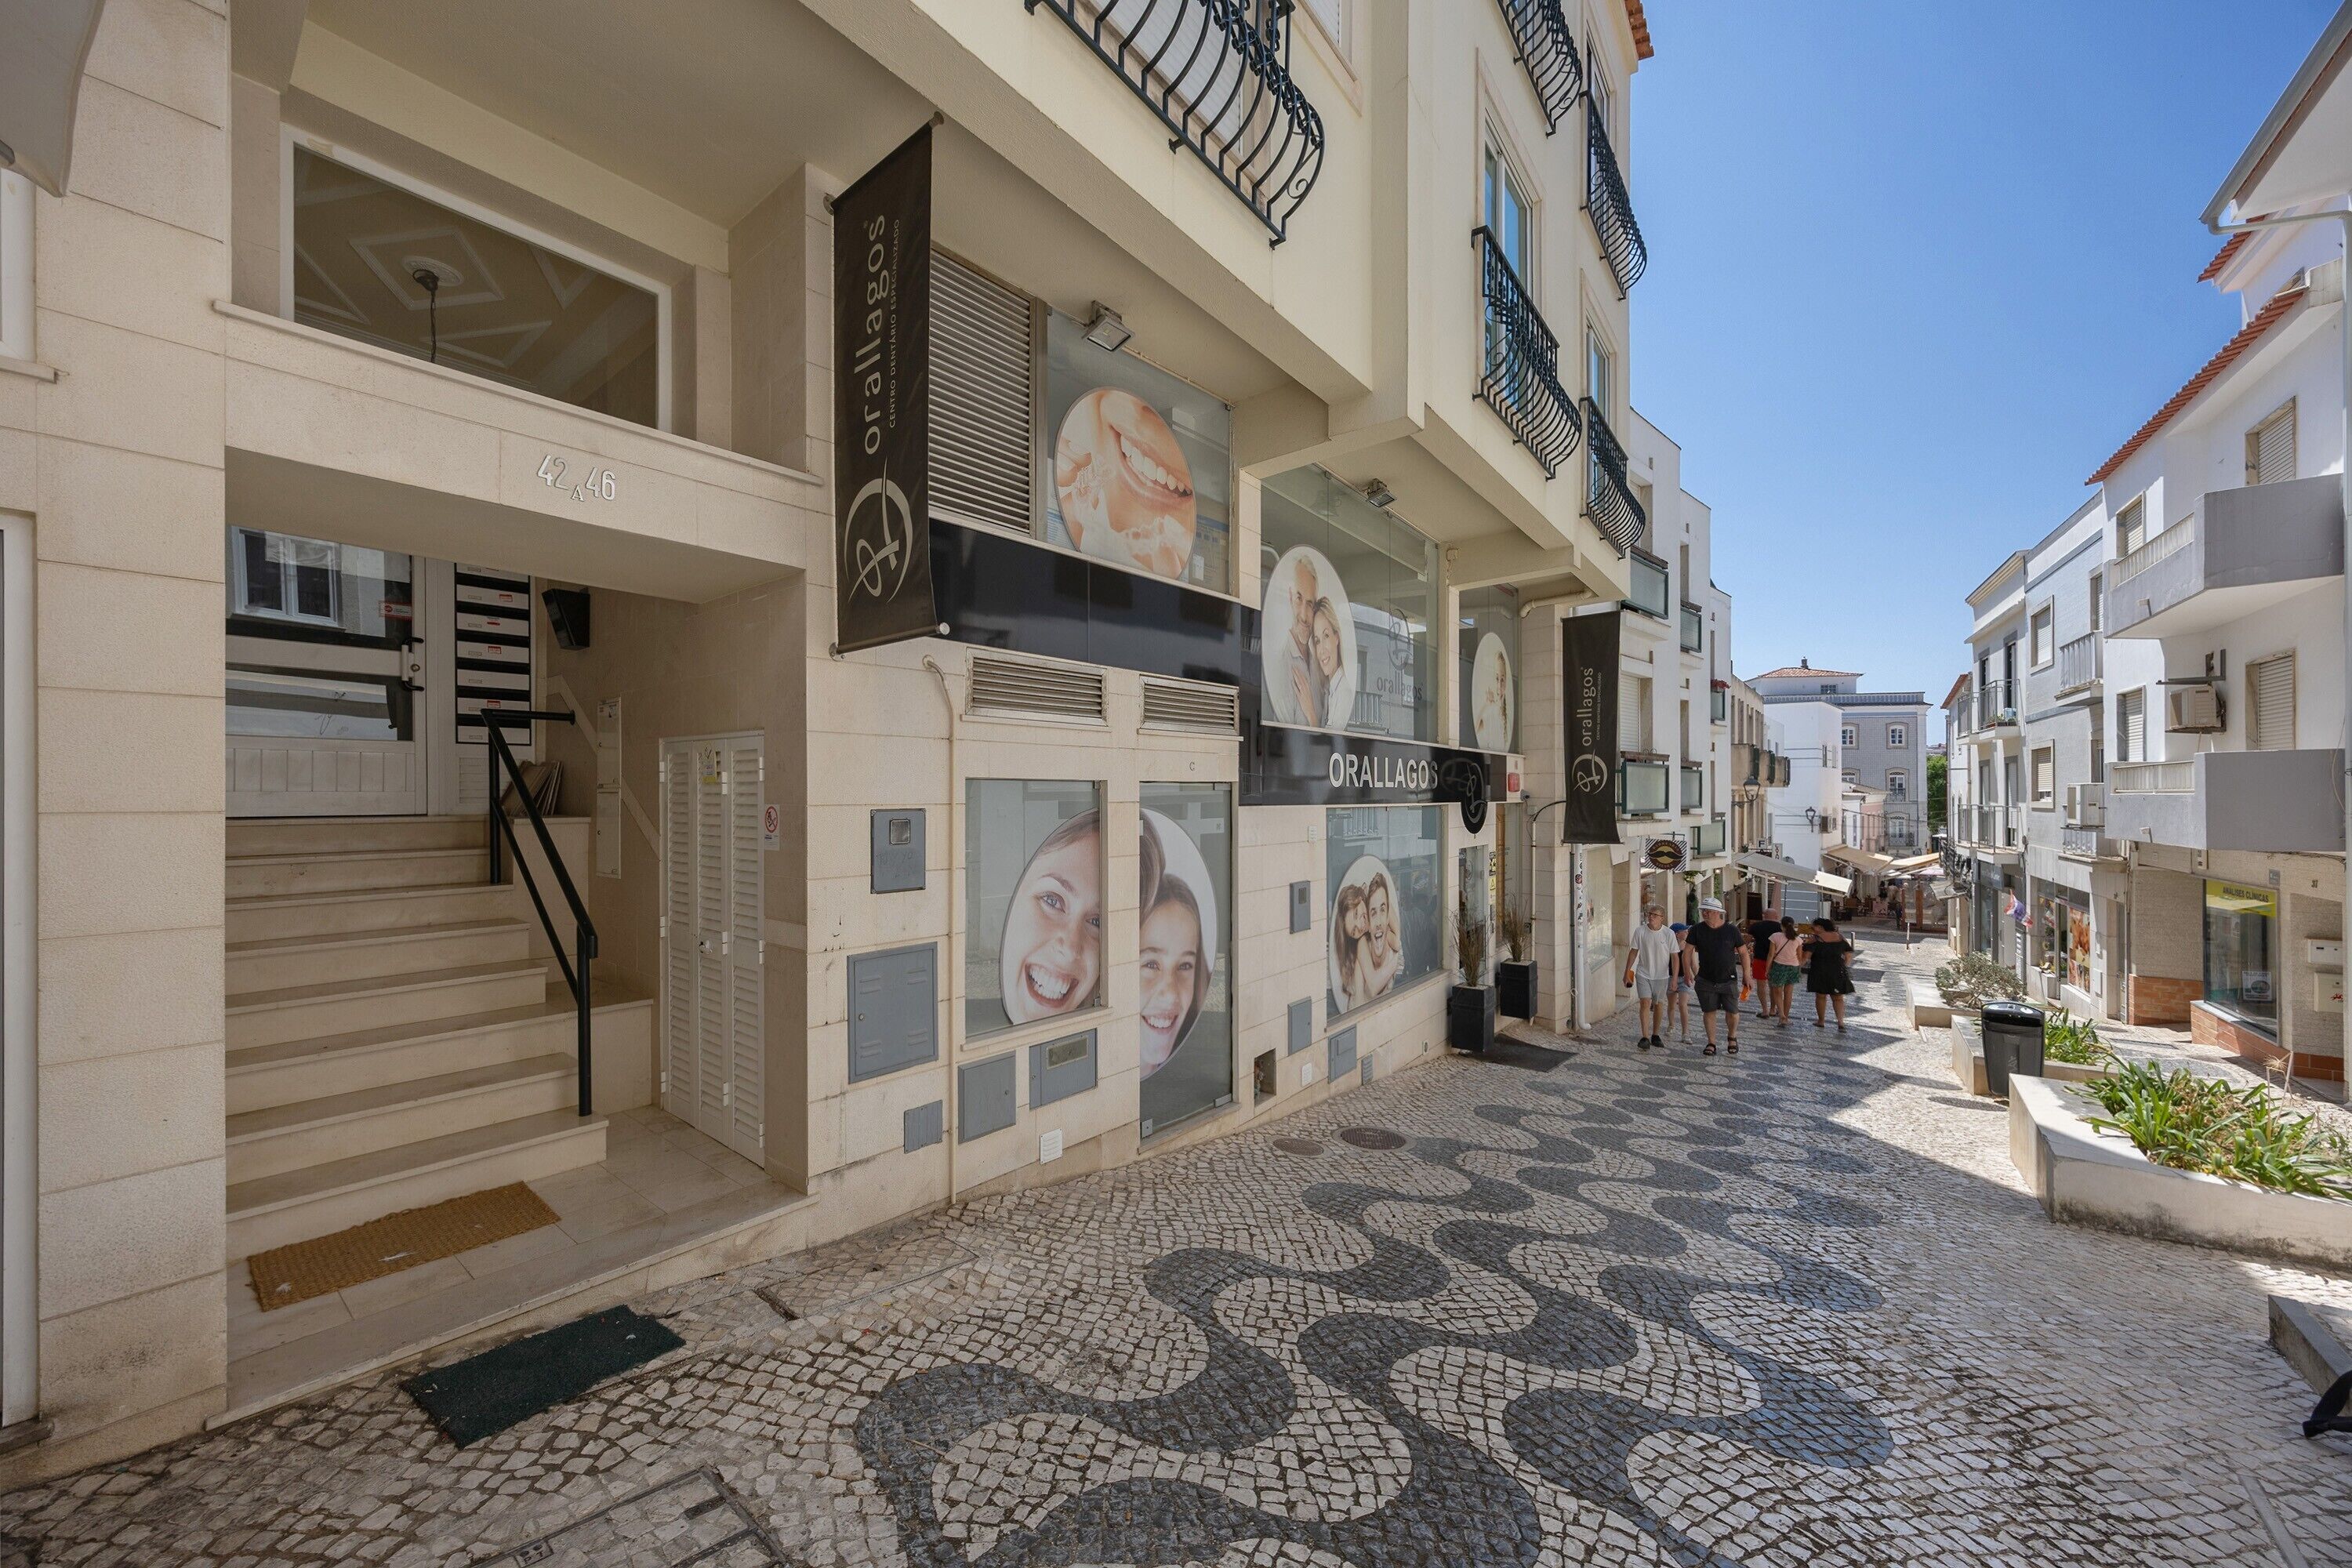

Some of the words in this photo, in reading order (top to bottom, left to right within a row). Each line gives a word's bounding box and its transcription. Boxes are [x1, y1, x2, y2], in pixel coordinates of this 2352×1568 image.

[891, 220, 899, 310] ESPECIALIZADO
[854, 215, 889, 455] orallagos
[537, 455, 569, 491] 42
[585, 466, 615, 501] 46
[1377, 677, 1423, 702] orallagos
[1576, 667, 1596, 746] orallagos
[1329, 753, 1438, 789] ORALLAGOS
